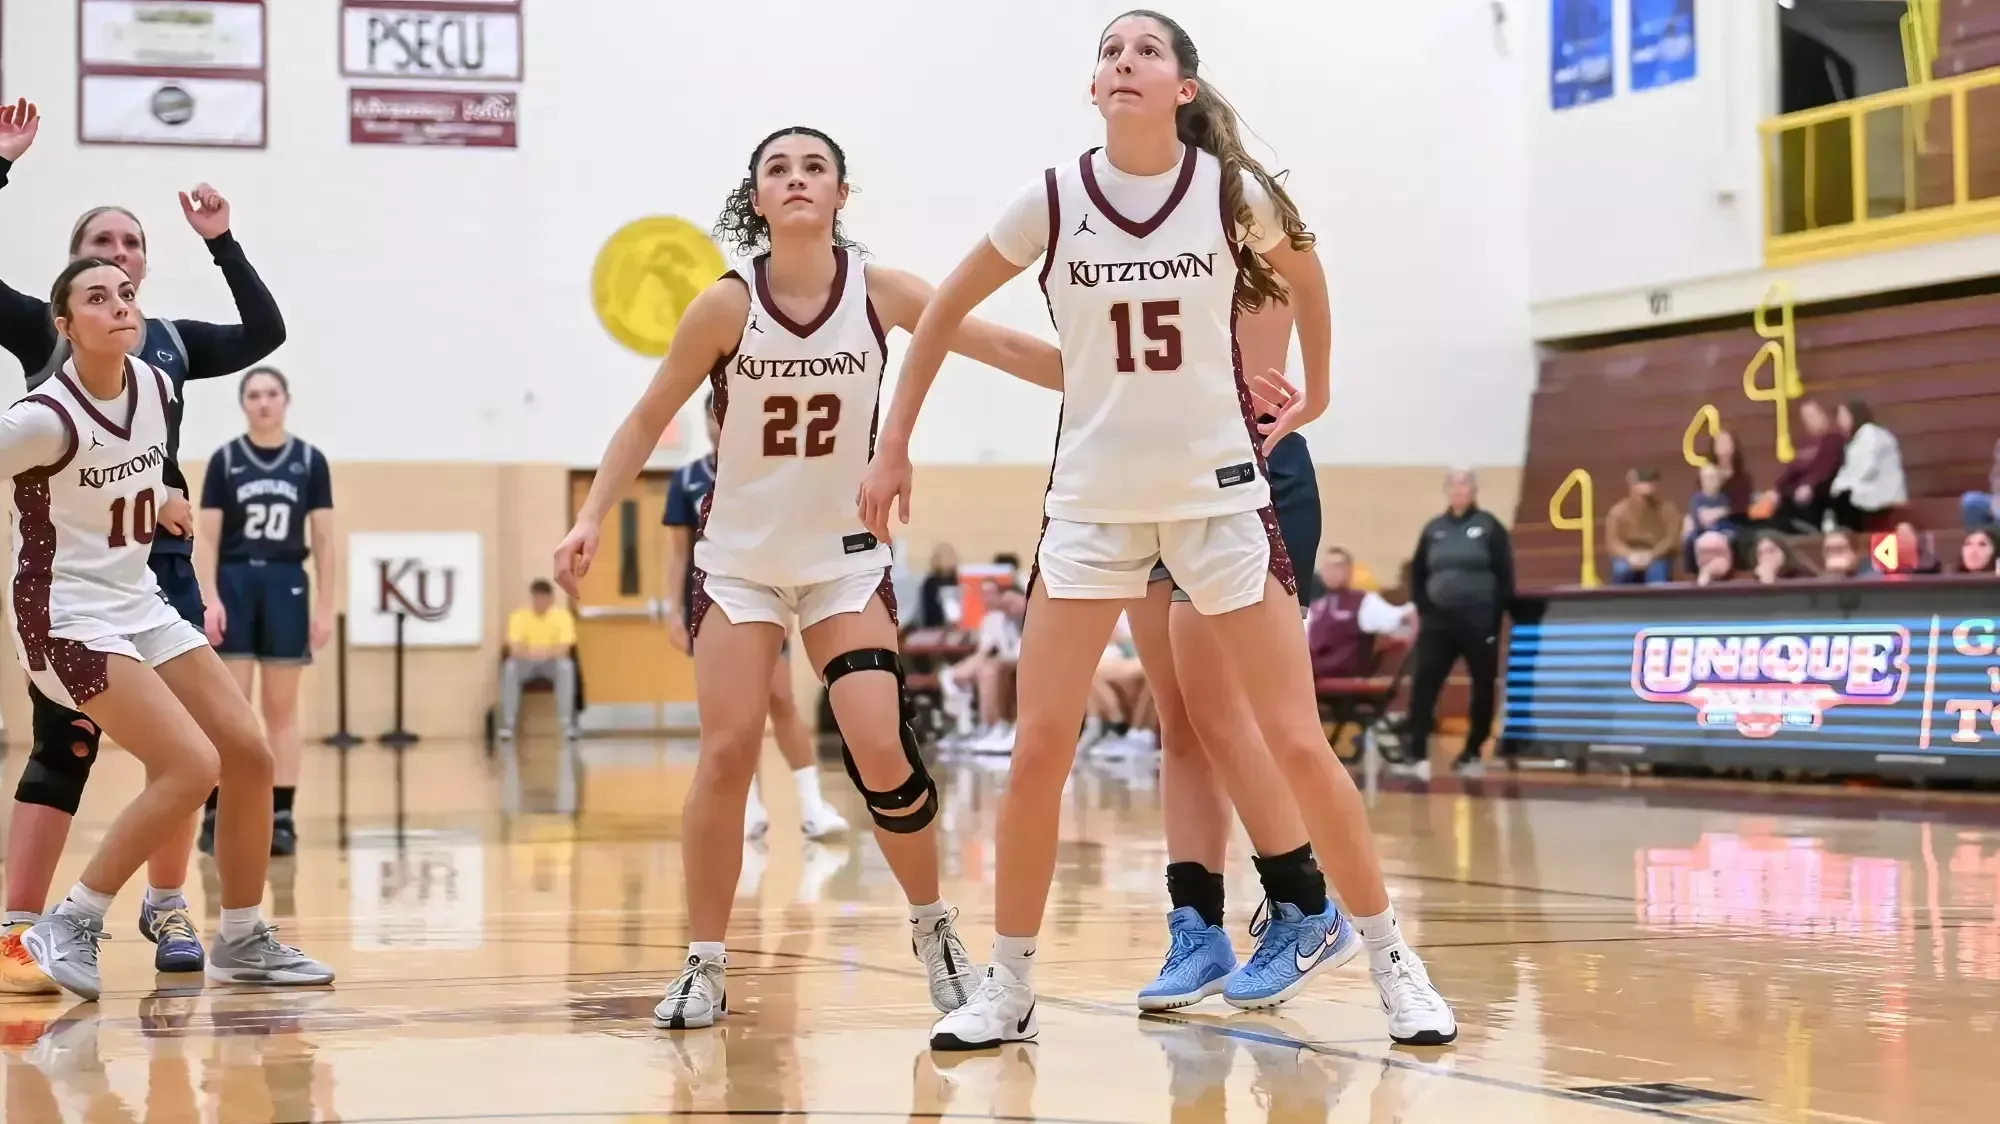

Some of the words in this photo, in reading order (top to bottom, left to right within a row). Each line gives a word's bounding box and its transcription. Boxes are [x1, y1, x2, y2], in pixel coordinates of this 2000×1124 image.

[368, 17, 486, 70] PSECU
[1067, 252, 1218, 288] KUTZTOWN
[735, 351, 870, 380] KUTZTOWN
[1109, 299, 1184, 373] 15
[763, 393, 842, 458] 22
[107, 487, 156, 549] 10
[244, 502, 291, 541] 20
[371, 557, 464, 622] KU
[1643, 635, 1896, 695] UNIQUE
